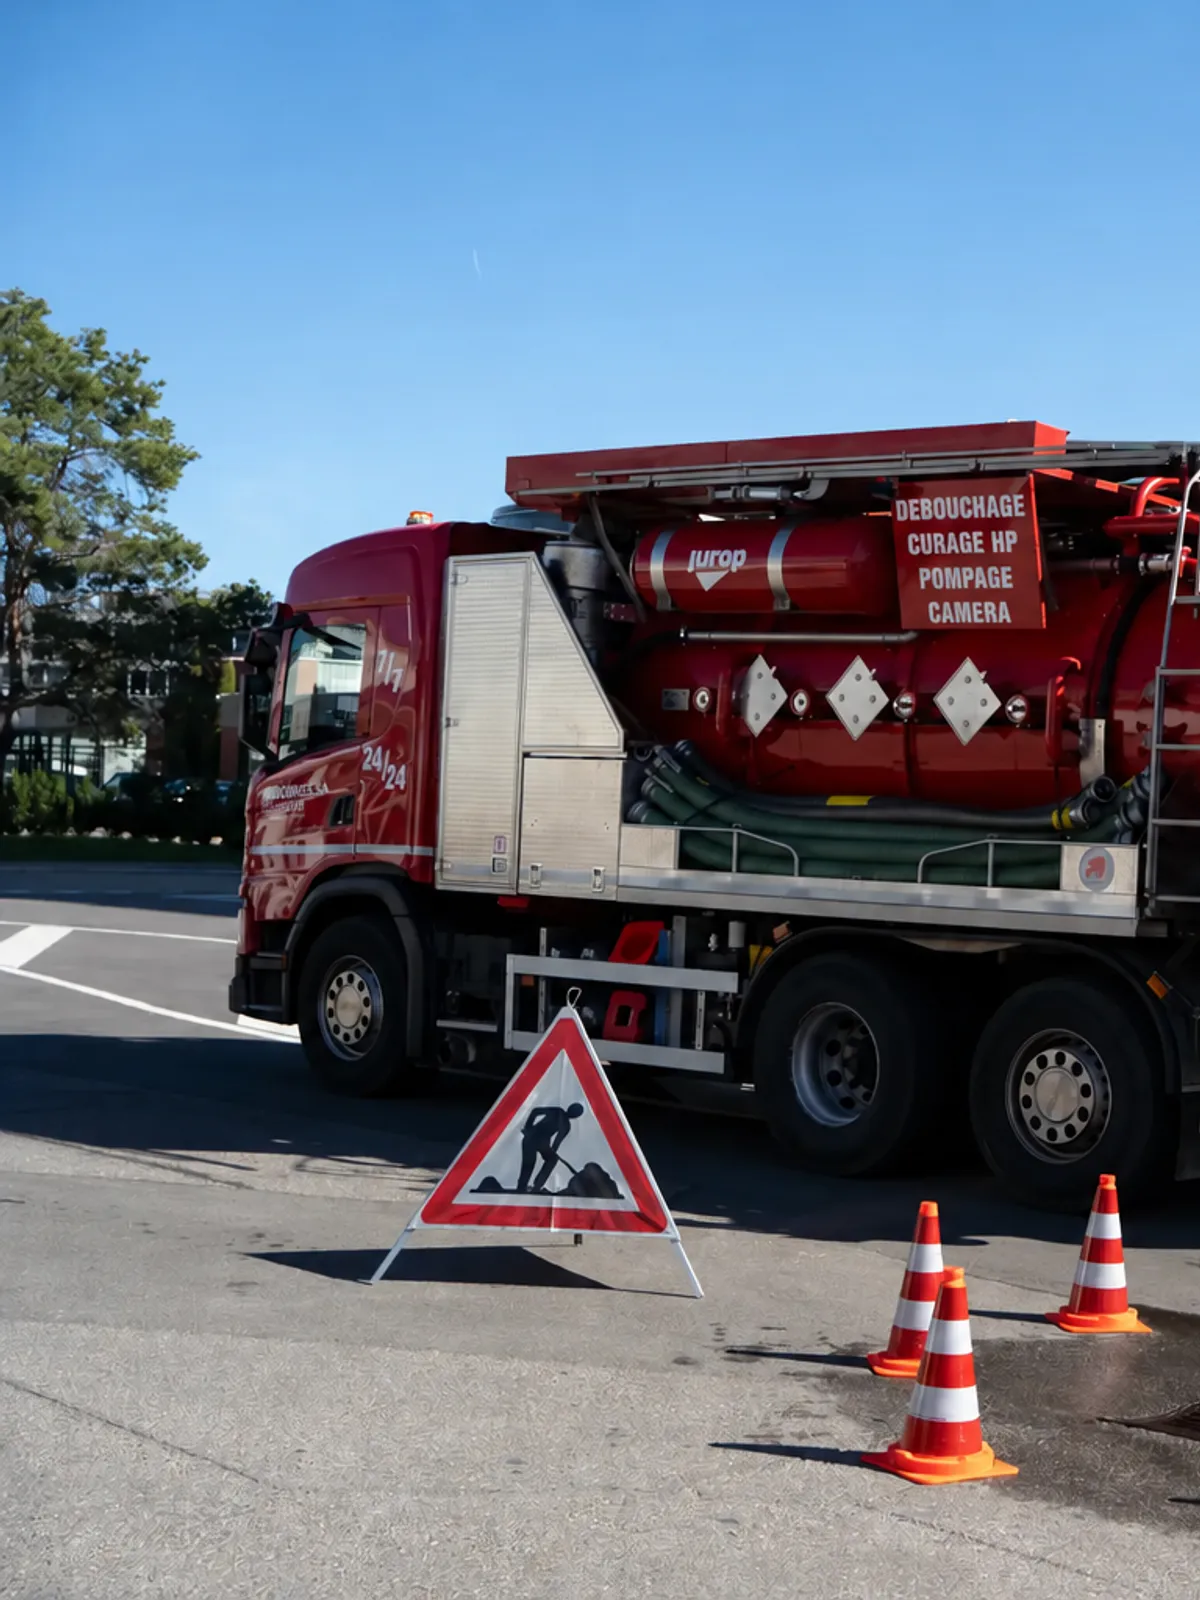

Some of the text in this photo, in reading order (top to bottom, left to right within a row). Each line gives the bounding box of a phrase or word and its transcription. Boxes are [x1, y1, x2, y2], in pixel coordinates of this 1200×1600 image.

[895, 494, 1026, 521] DEBOUCHAGE
[907, 530, 1018, 556] CURAGE HP
[918, 566, 1014, 590] POMPAGE
[928, 601, 1012, 624] CAMERA
[361, 746, 406, 790] 24/24
